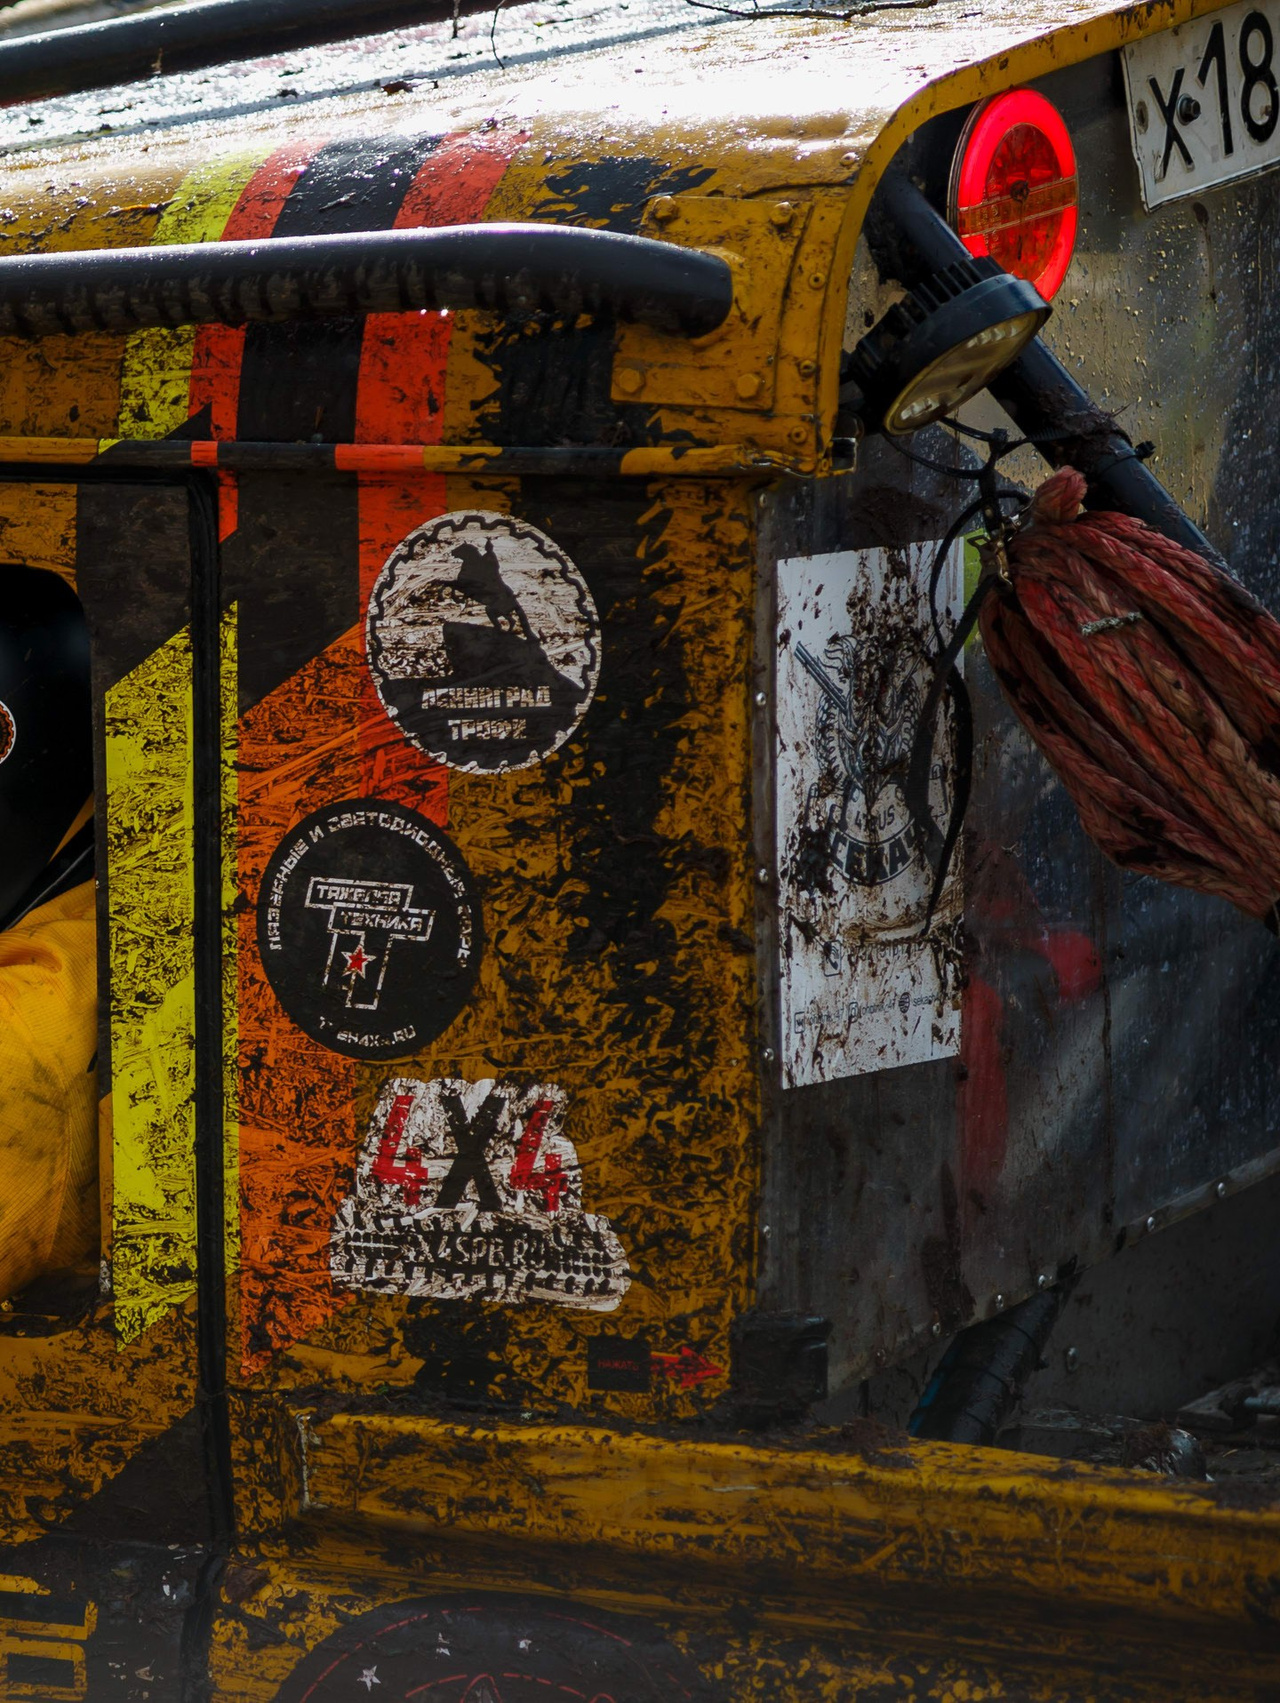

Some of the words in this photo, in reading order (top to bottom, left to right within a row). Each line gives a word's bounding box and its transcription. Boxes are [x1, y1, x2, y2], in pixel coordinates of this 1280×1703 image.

[421, 686, 552, 709] ЛЕНИНГРАД
[448, 719, 527, 741] ТРОФИ
[308, 825, 325, 843] И
[340, 911, 423, 932] ТЕХНИКА
[371, 1095, 568, 1212] 4X4
